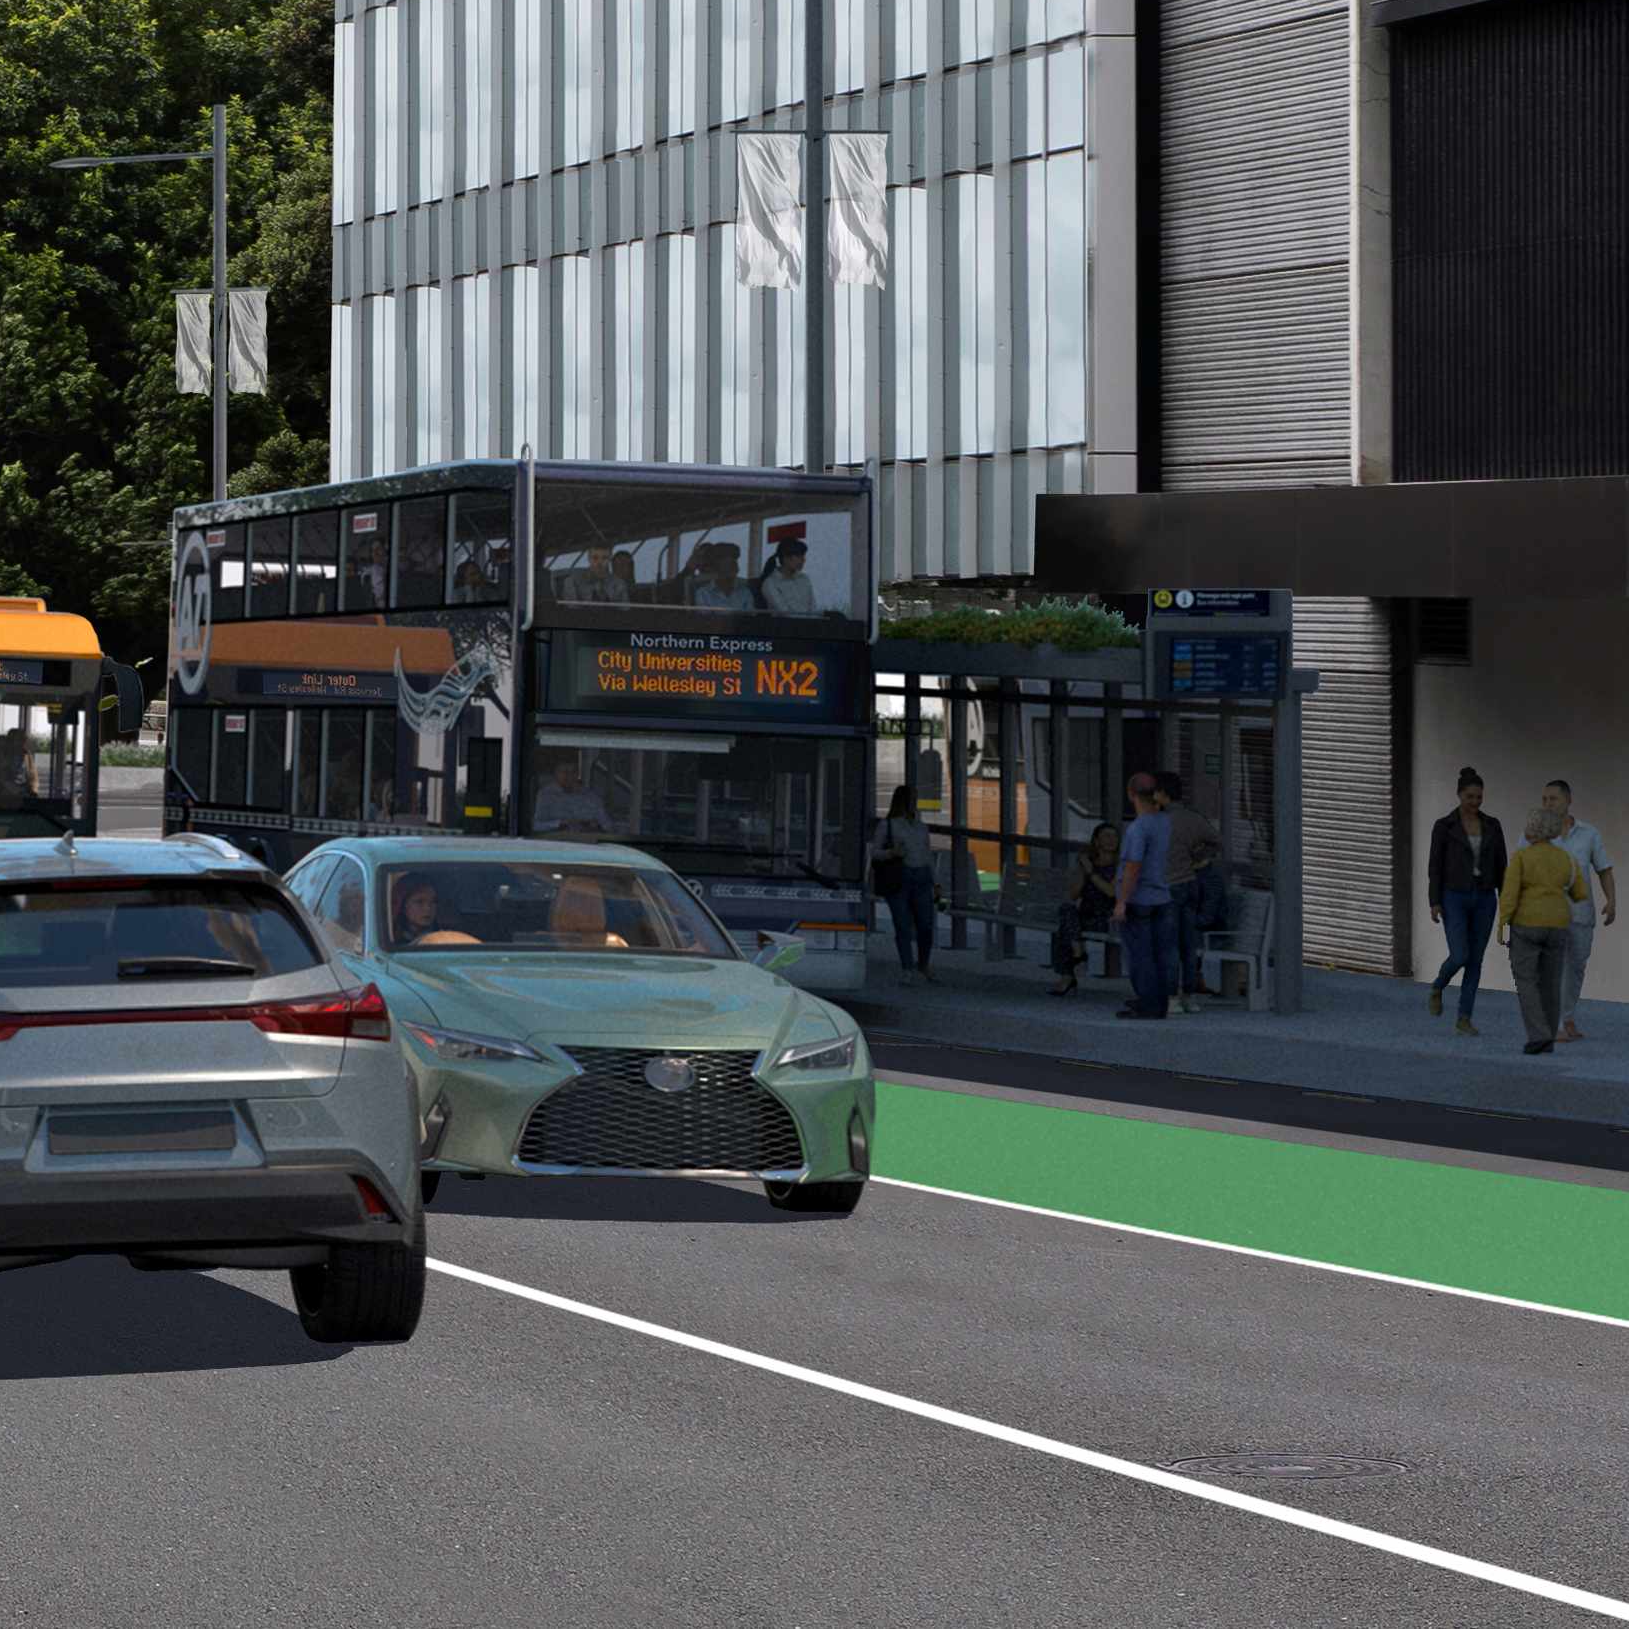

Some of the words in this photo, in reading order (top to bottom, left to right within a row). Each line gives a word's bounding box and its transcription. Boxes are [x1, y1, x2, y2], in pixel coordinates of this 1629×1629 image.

[630, 633, 705, 649] Northern
[709, 636, 773, 653] Express
[597, 651, 632, 671] City
[638, 653, 742, 672] Universities
[597, 673, 627, 691] Via
[632, 674, 717, 698] Wellesley
[722, 677, 742, 695] St
[757, 659, 819, 696] NX2
